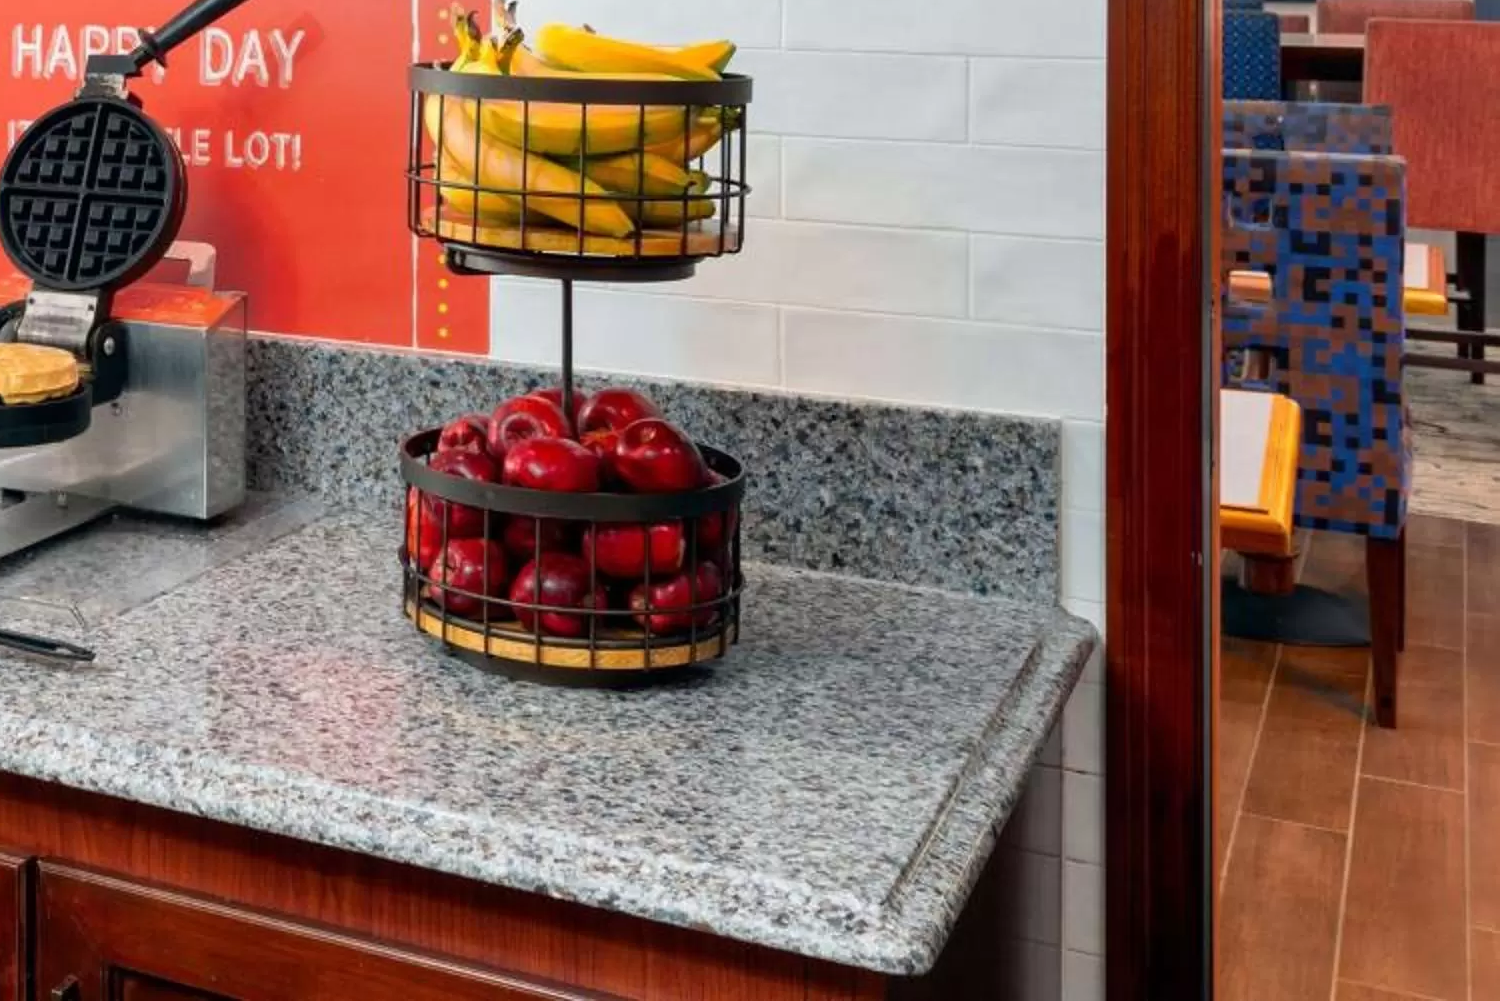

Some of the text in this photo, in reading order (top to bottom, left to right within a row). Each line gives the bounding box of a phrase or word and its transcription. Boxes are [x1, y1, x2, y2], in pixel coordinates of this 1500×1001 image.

[11, 22, 166, 85] HAPP
[200, 27, 305, 88] DAY
[225, 130, 302, 170] LOT!
